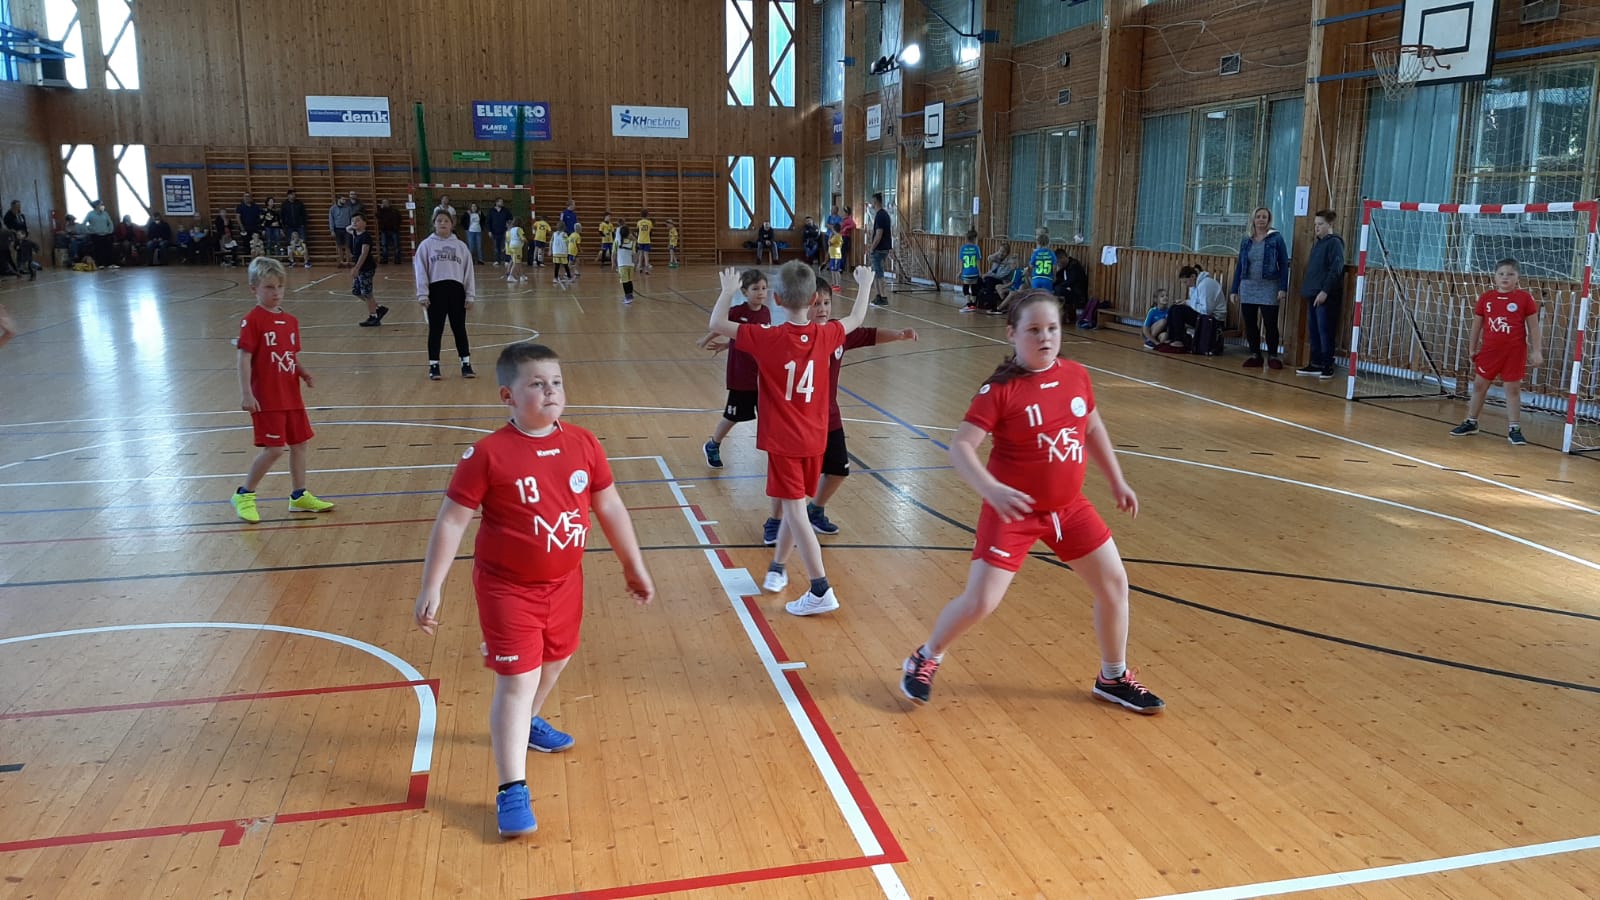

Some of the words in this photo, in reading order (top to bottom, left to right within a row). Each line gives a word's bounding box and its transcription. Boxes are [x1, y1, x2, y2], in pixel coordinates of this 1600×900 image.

[963, 255, 976, 269] 34
[1035, 260, 1052, 275] 35
[1486, 302, 1492, 313] 5
[264, 331, 277, 346] 12
[784, 359, 814, 403] 14
[1024, 403, 1043, 428] 11
[515, 476, 540, 504] 13
